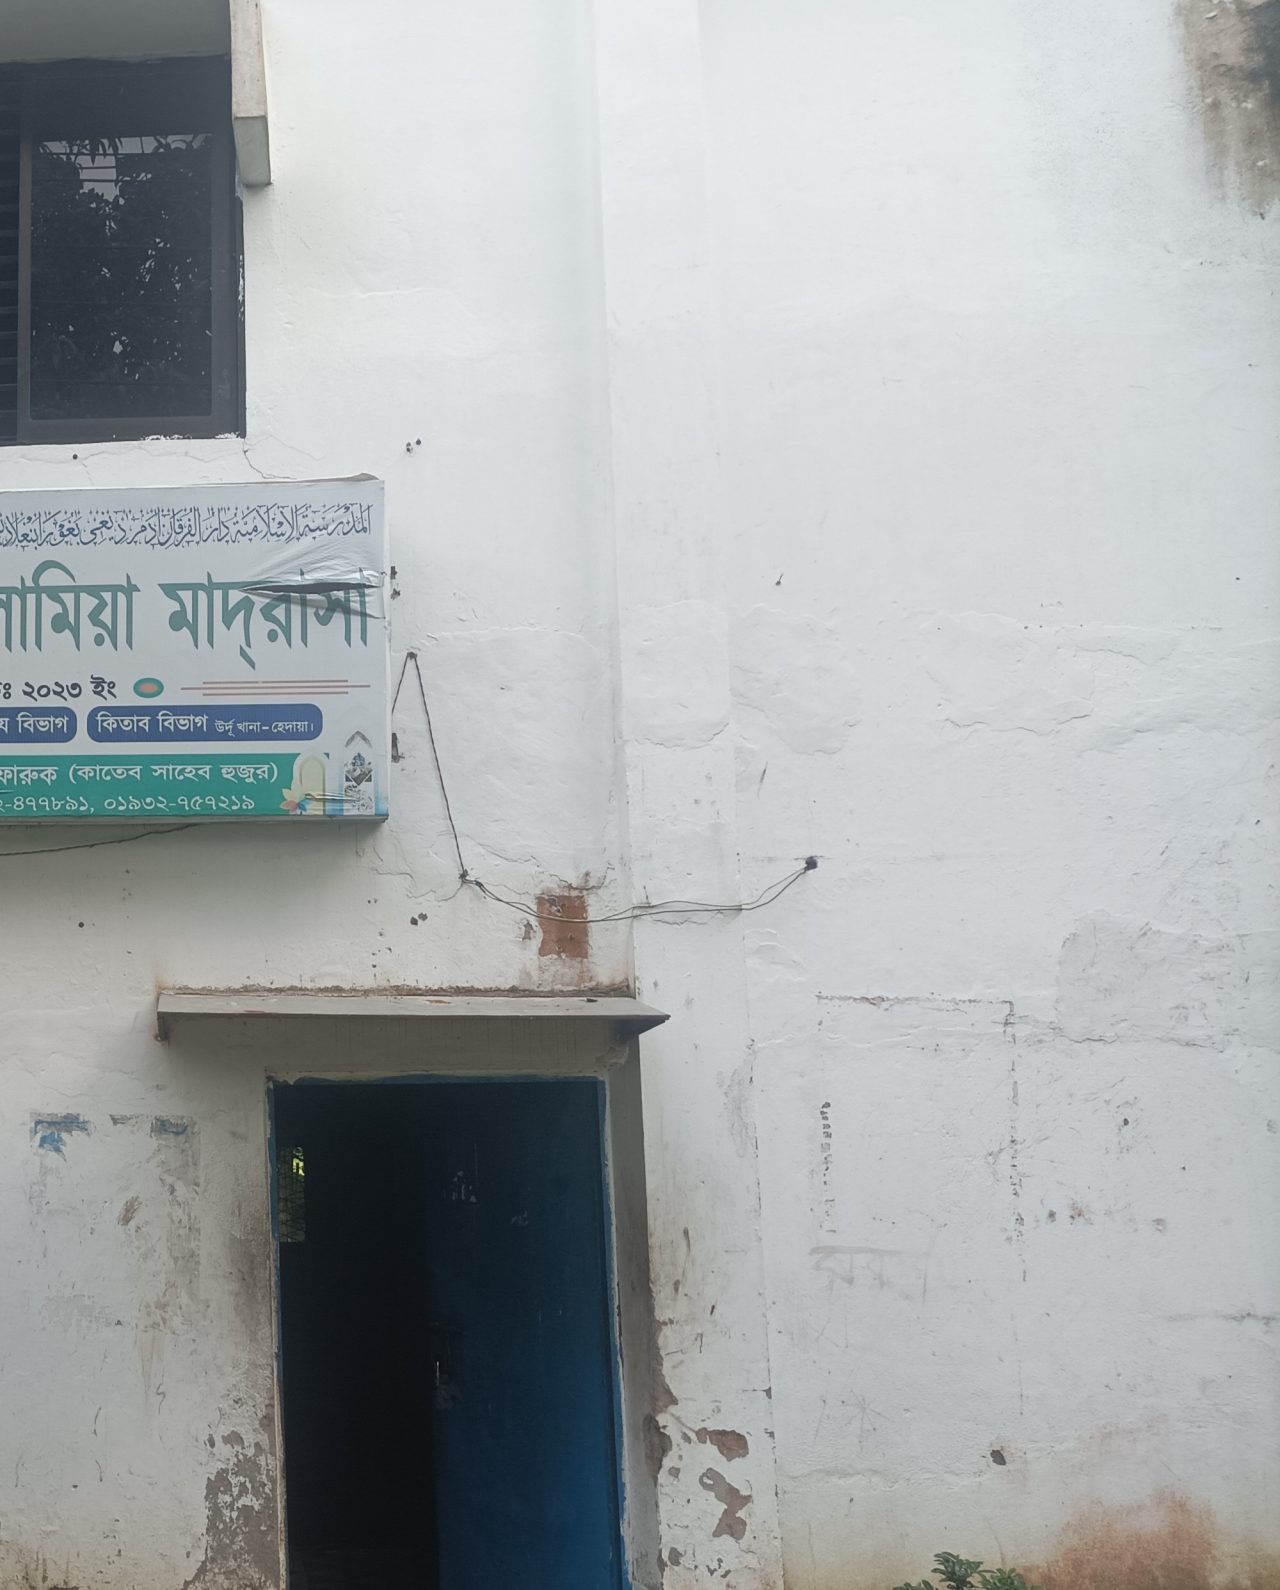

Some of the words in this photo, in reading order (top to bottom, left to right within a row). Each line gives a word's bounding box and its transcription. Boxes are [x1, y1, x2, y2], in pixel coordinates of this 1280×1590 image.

[22, 681, 81, 703] ২০২৩
[90, 675, 117, 703] ইং
[16, 712, 69, 734] বিভাগ
[95, 712, 150, 734] কিতাব
[156, 711, 209, 732] বিভাগ
[69, 763, 142, 785] (কাতেব
[151, 764, 212, 781] সাহেব
[220, 762, 278, 784] হুজুর)
[104, 795, 255, 812] ০১৯৩২-৭৫৭২১৯
